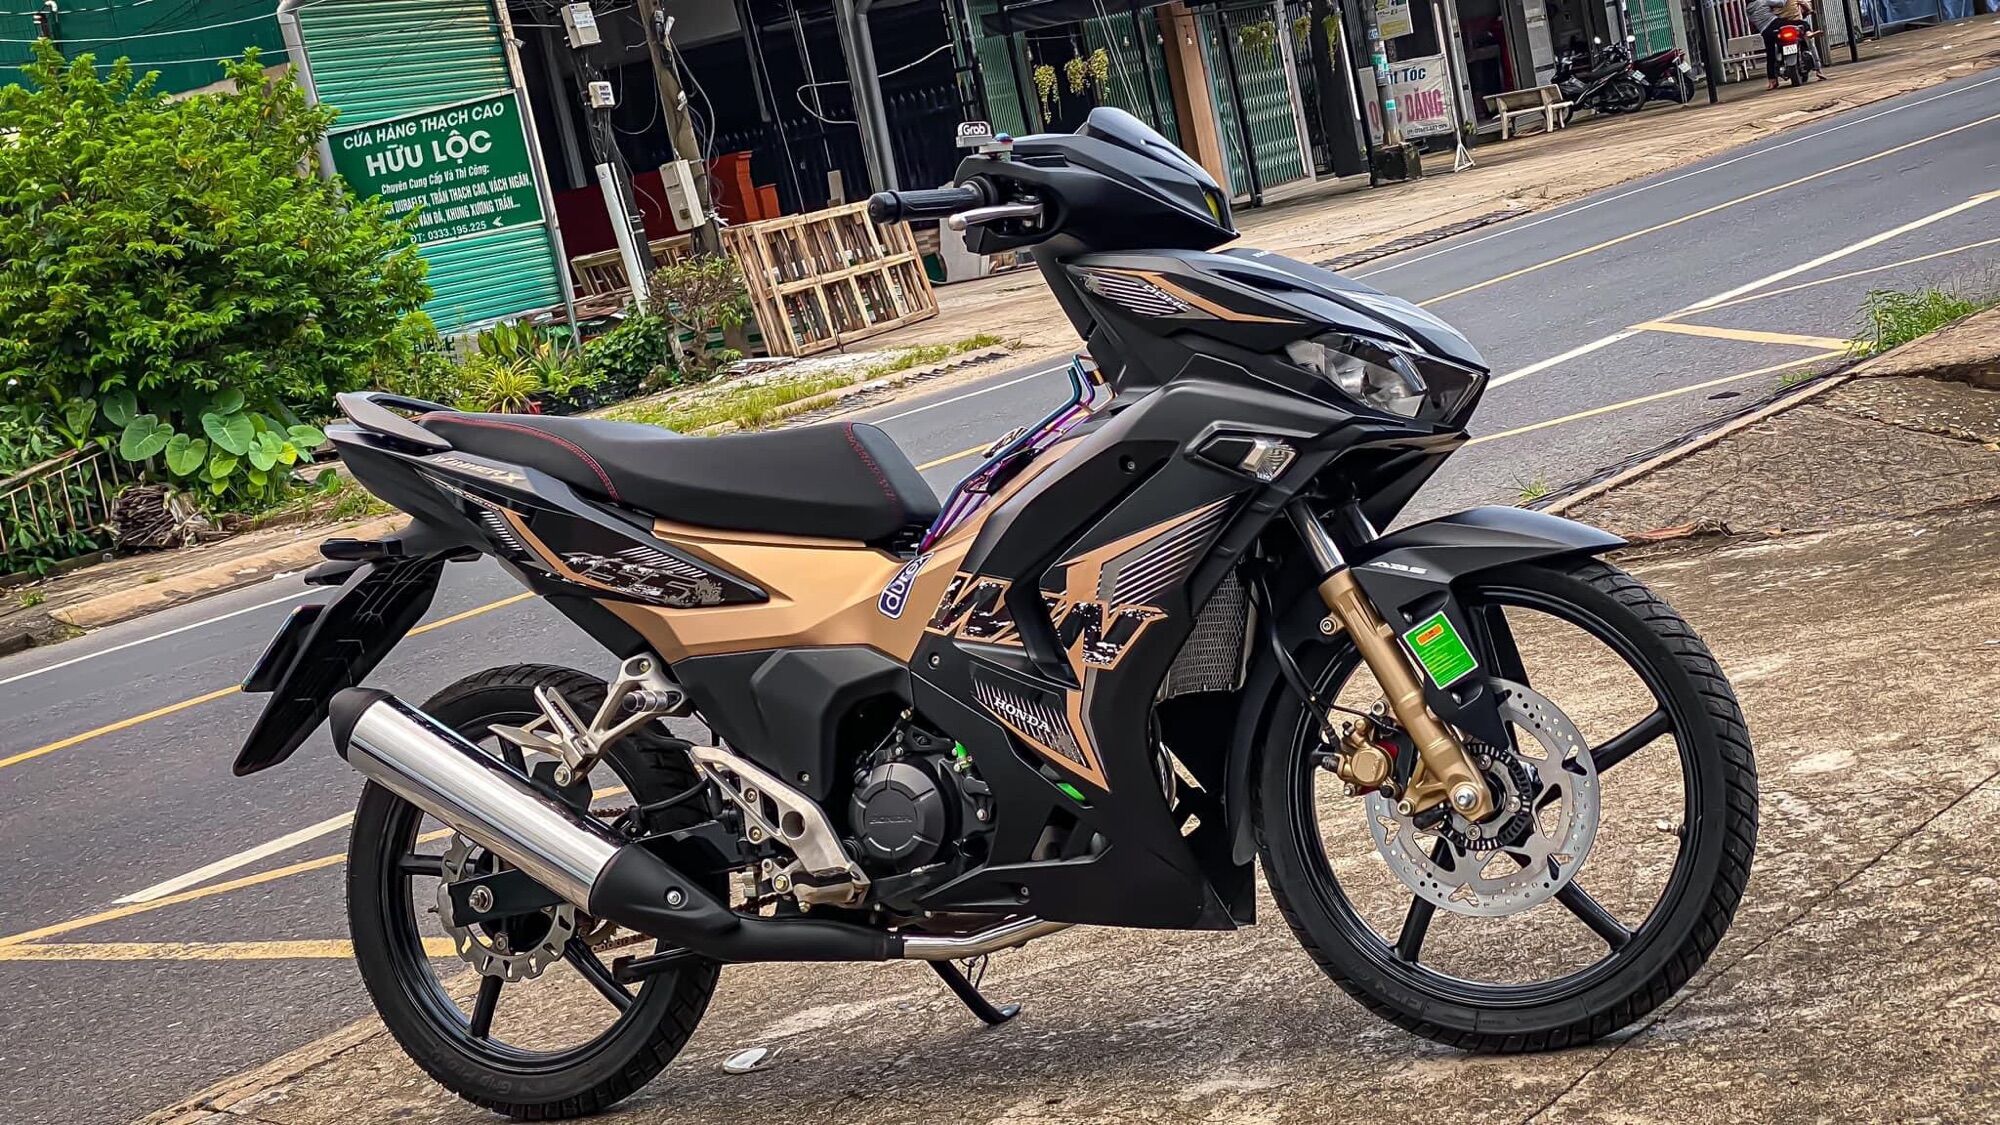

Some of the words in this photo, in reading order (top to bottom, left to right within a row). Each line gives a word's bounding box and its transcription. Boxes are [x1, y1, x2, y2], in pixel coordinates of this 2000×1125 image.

[376, 121, 417, 143] HÀNG
[420, 108, 469, 133] THẠCH
[471, 101, 505, 121] CAO
[365, 143, 424, 177] HỮU
[431, 129, 493, 164] LỘC
[408, 177, 428, 189] Cung
[445, 204, 471, 222] KHUNG
[427, 220, 487, 240] 0333.195.225
[993, 696, 1051, 733] HONDA
